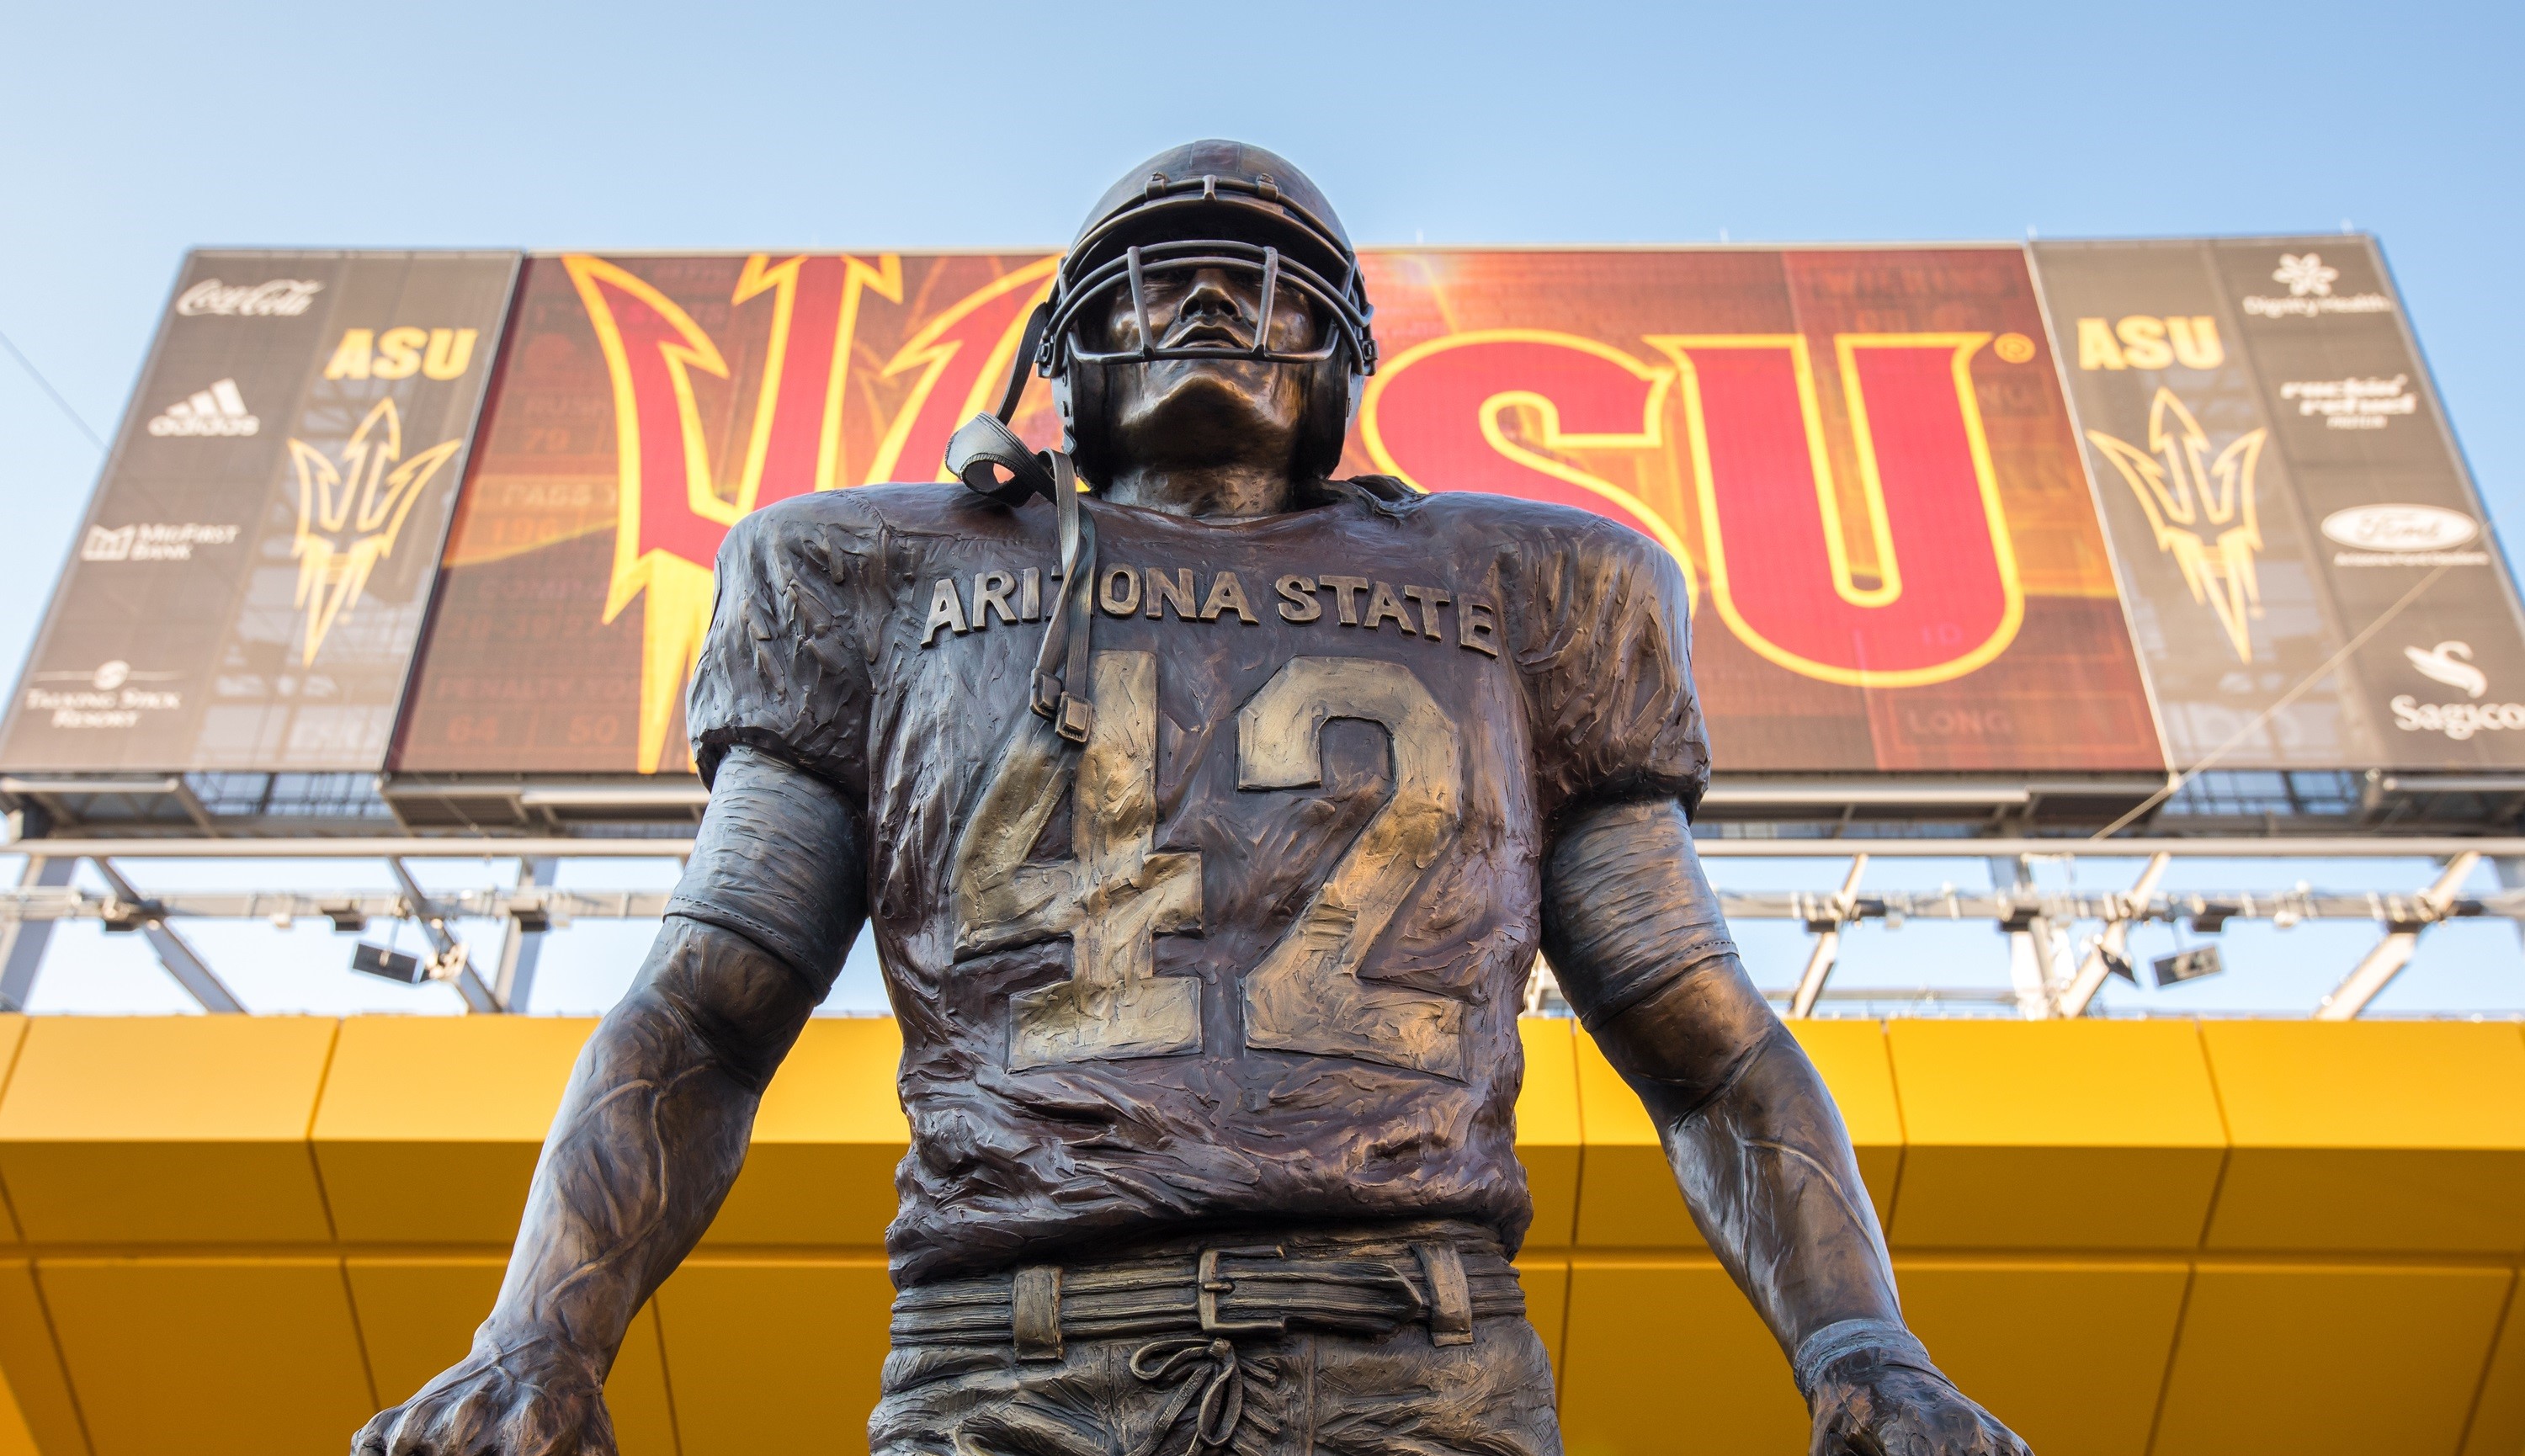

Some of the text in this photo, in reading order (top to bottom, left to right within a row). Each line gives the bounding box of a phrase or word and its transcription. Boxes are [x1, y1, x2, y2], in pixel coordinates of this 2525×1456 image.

[323, 326, 479, 380] ASU
[2077, 314, 2225, 370] ASU
[147, 415, 260, 437] adidas
[921, 562, 1499, 658] ARIONA STATE
[1907, 709, 2012, 736] LONG
[2389, 694, 2525, 741] Sagico
[952, 648, 1467, 1082] 42
